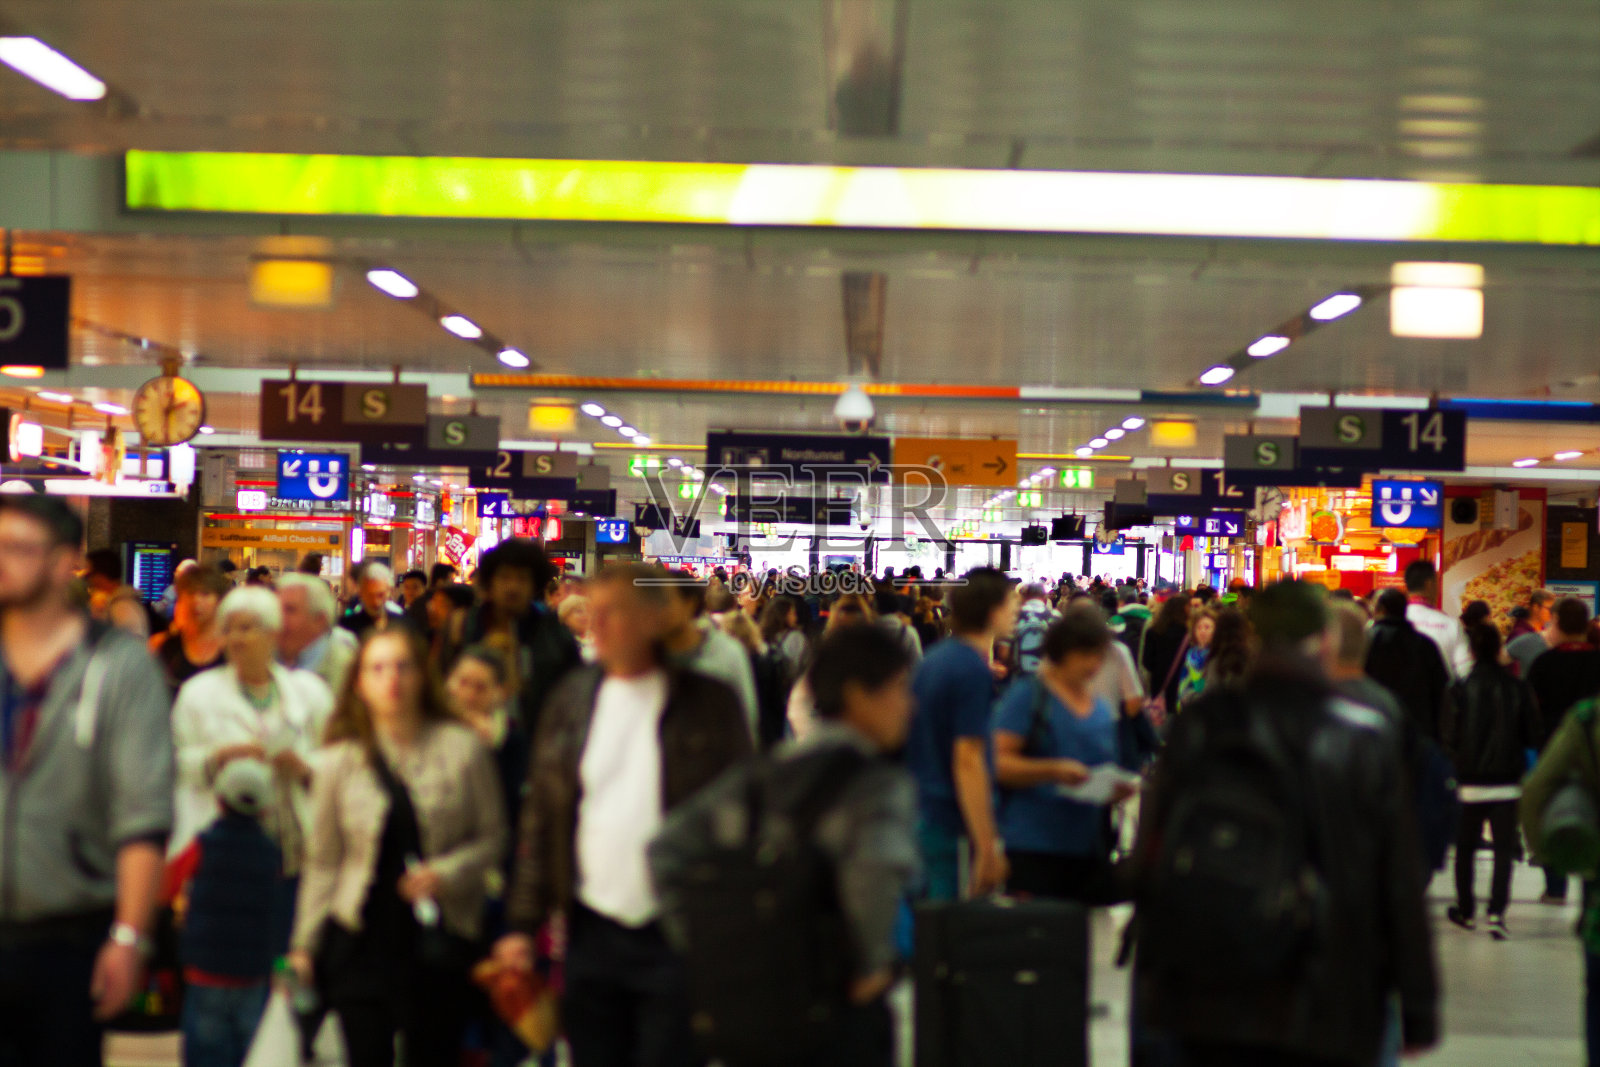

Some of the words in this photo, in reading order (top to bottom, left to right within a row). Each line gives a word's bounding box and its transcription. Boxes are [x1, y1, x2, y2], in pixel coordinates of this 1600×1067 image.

[279, 383, 324, 424] 14
[362, 390, 388, 419] S
[445, 421, 467, 446] S
[1337, 415, 1363, 443] S
[1402, 412, 1447, 452] 14
[781, 448, 845, 462] Nordtunnel
[1257, 441, 1281, 466] S
[536, 454, 552, 474] S
[1172, 472, 1189, 491] S
[637, 504, 649, 520] 7
[1037, 526, 1046, 539] 5
[1073, 515, 1084, 532] 7
